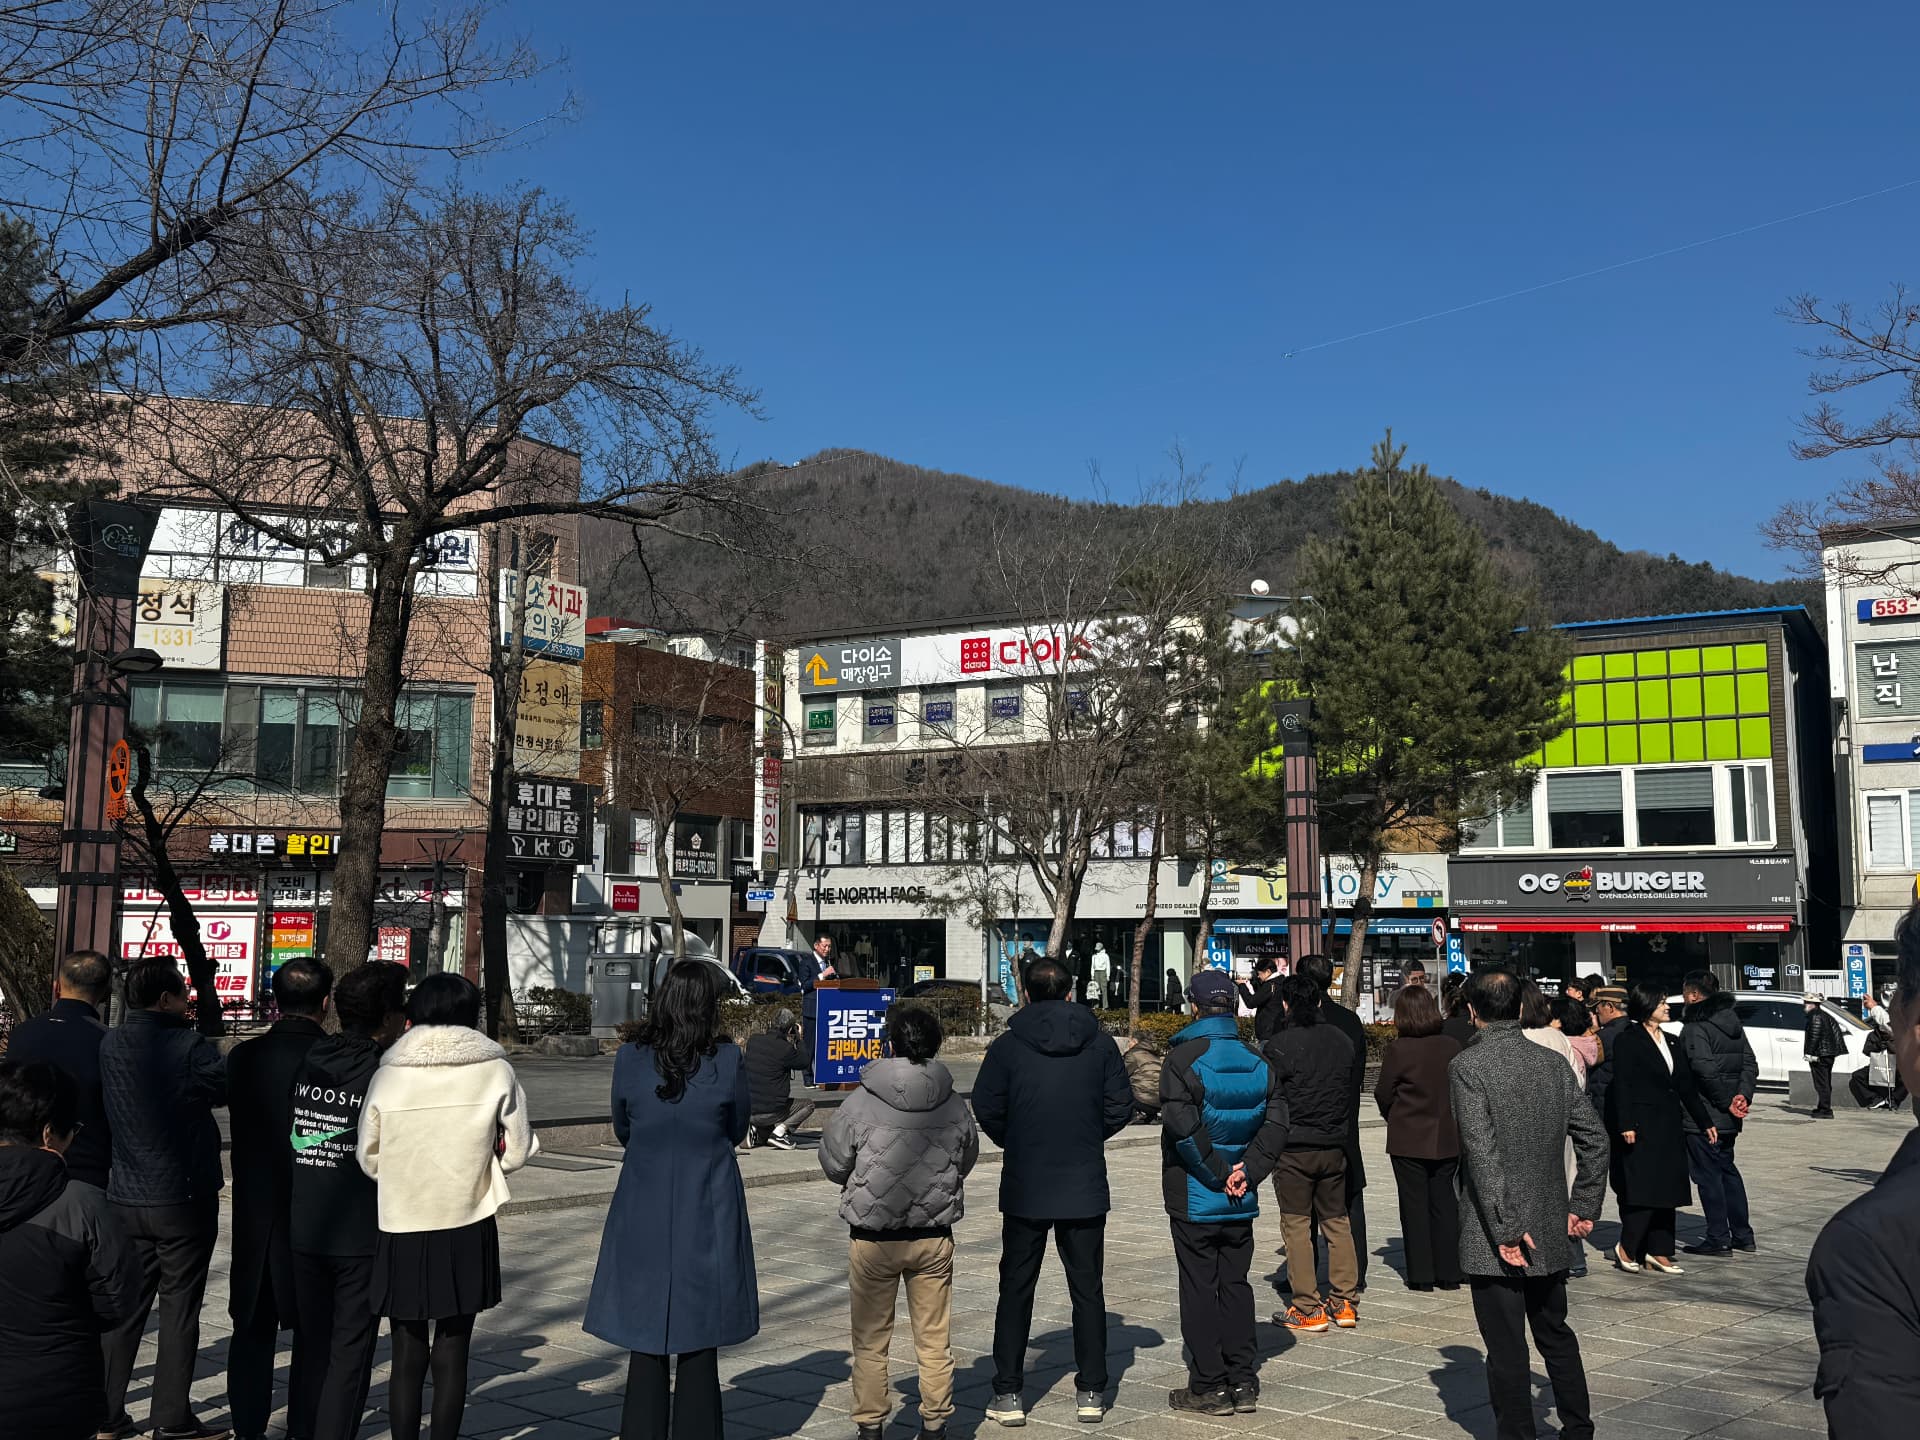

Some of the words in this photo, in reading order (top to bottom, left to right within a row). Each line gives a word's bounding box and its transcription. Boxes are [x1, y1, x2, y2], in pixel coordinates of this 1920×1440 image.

[842, 646, 892, 664] 다이소
[841, 665, 892, 684] 매장입구
[518, 782, 572, 810] 휴대폰
[507, 806, 581, 834] 할인매장
[208, 832, 276, 855] 휴대폰
[286, 834, 330, 855] 할인
[534, 838, 551, 856] kt
[1519, 873, 1561, 892] OG
[1596, 871, 1706, 892] BURGER
[808, 887, 835, 904] THE
[839, 887, 888, 904] NORTH
[890, 886, 926, 904] FACE
[1208, 898, 1240, 906] 53-5080
[828, 1009, 886, 1039] 김동구
